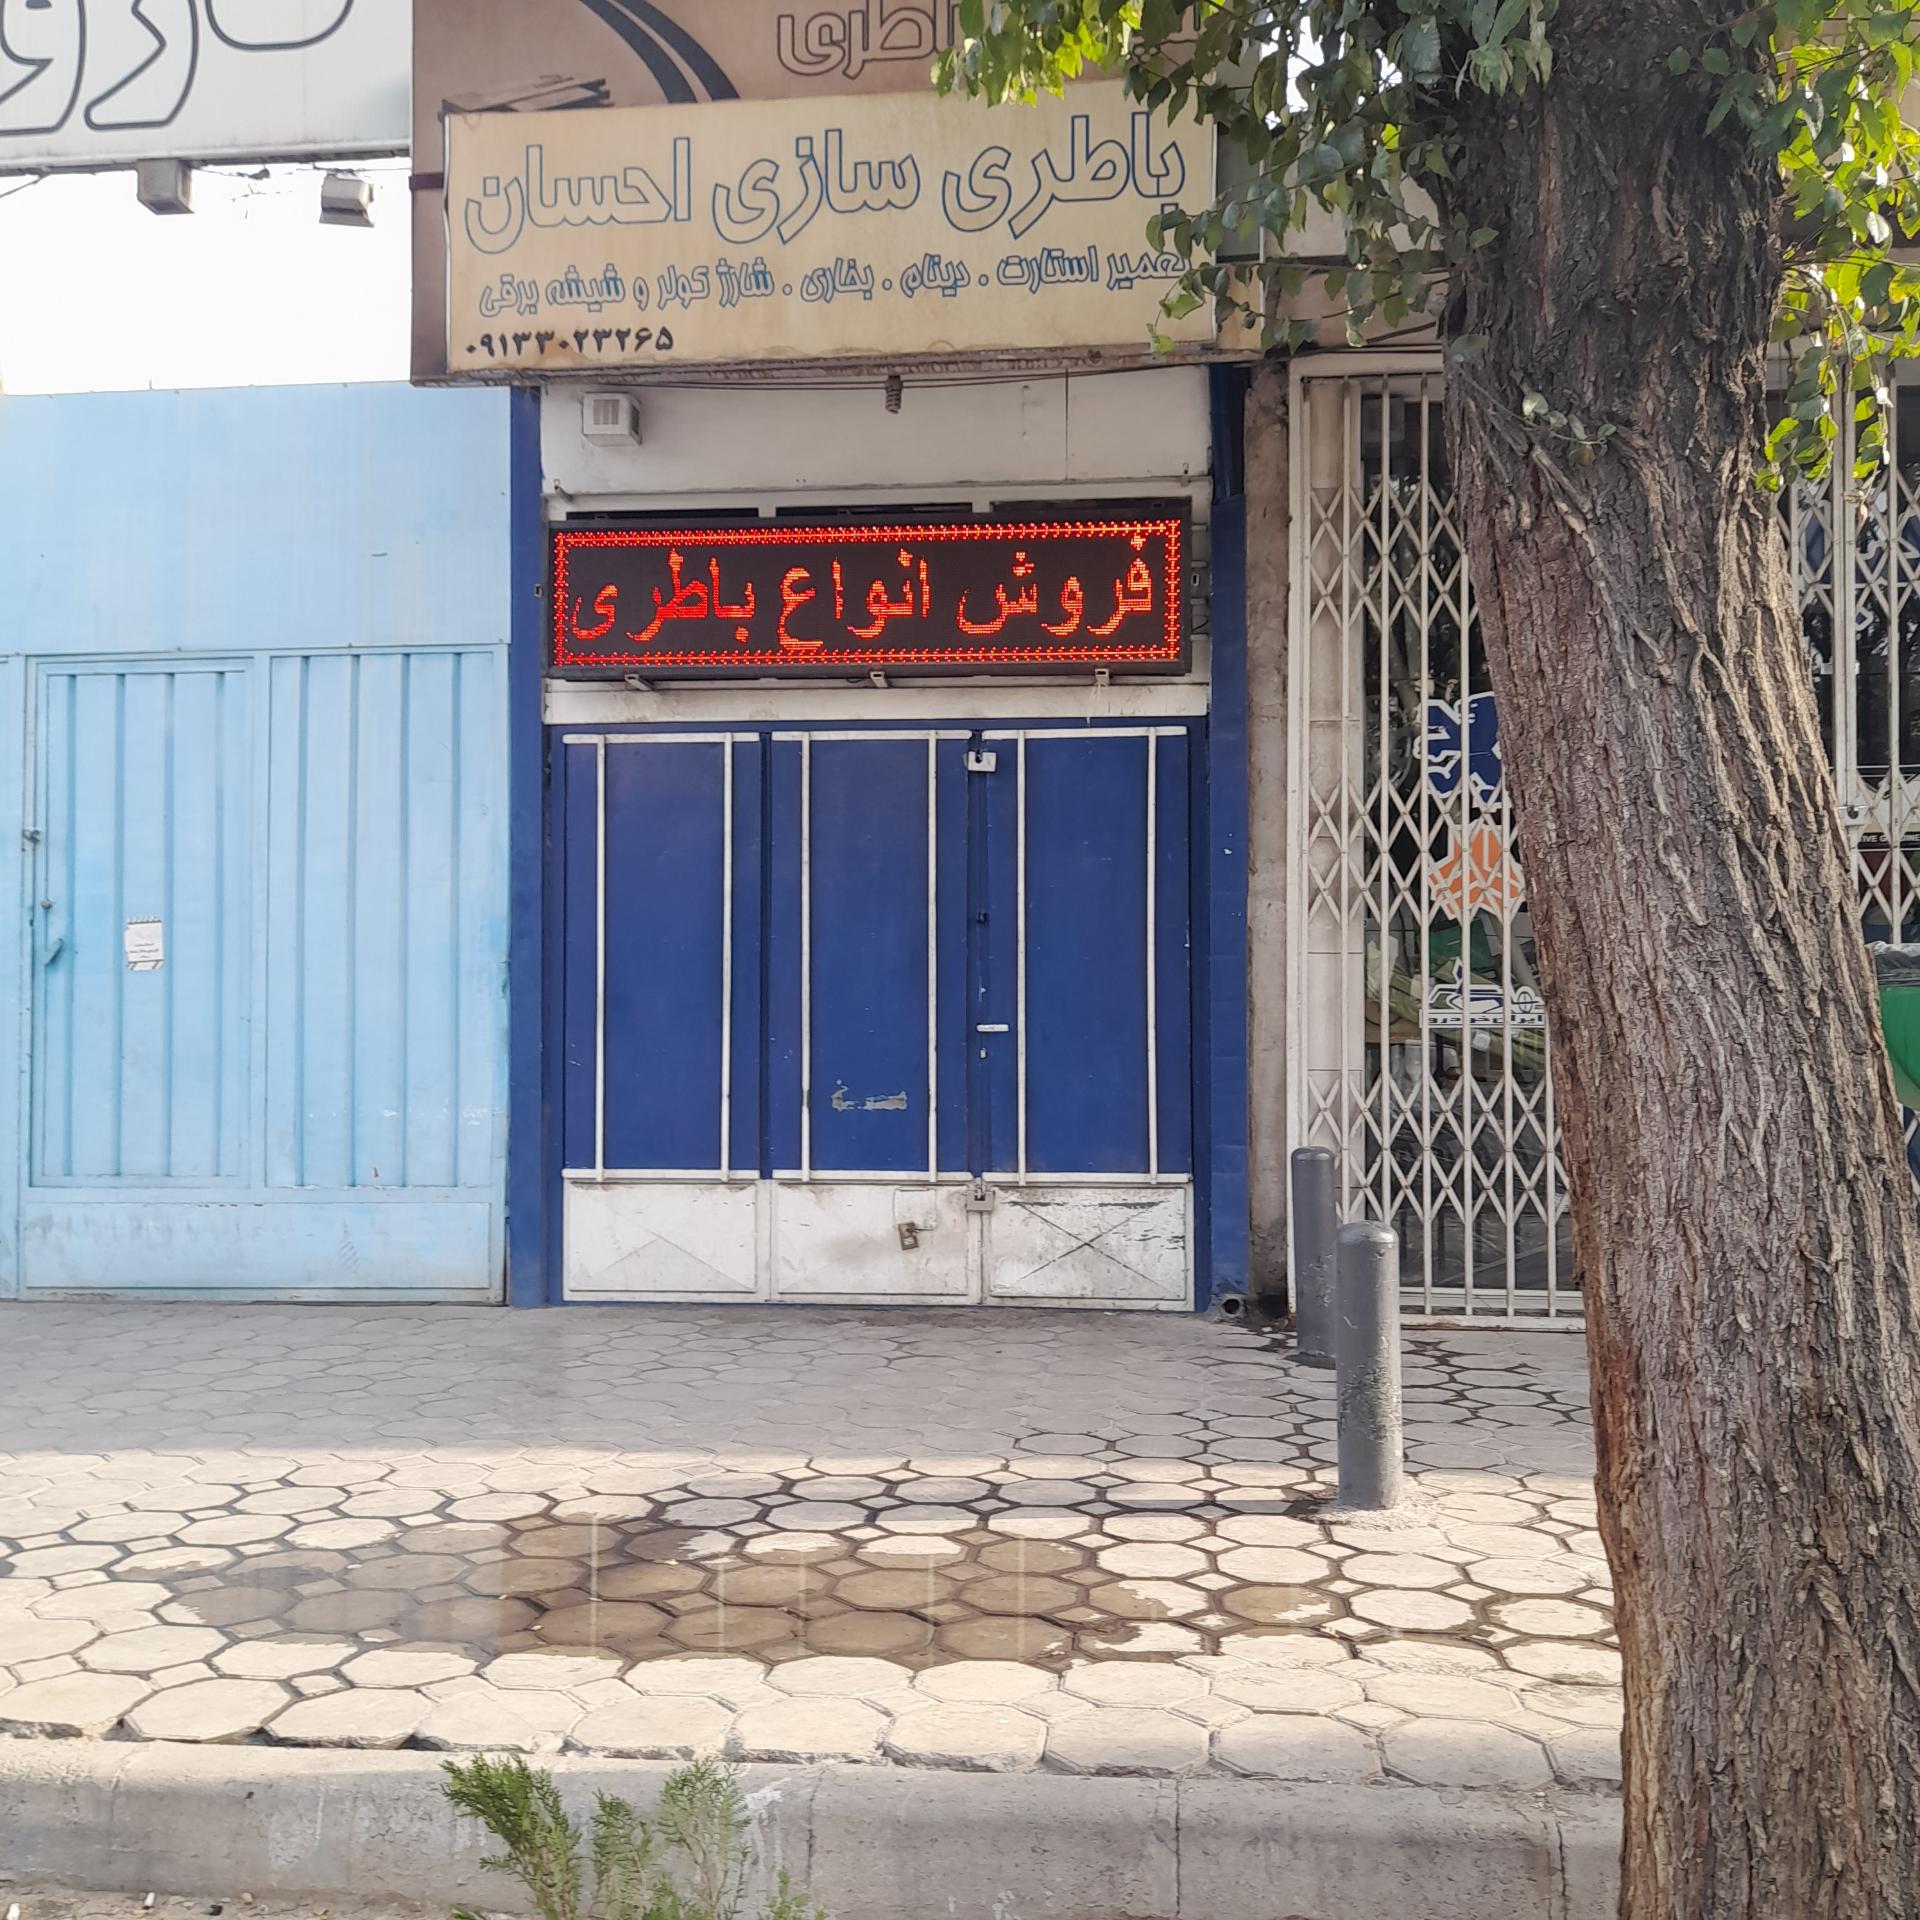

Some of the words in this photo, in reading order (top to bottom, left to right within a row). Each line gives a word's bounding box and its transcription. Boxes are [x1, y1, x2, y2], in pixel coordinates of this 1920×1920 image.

[465, 137, 691, 254] احسان
[712, 128, 920, 244] سازی
[942, 111, 1185, 240] باطری
[545, 263, 627, 313] شیشه
[632, 276, 650, 311] و
[657, 264, 711, 310] کولر
[714, 256, 775, 309] شارژ
[800, 256, 875, 303] بخاری
[900, 253, 971, 298] دینام
[997, 245, 1099, 294] استارت
[479, 273, 540, 318] برقی
[466, 325, 674, 358] ۰۹۱۳۳۰۲۳۲۶۵
[572, 547, 756, 643] باطری
[777, 547, 931, 651] انواع
[957, 535, 1152, 637] فروش
